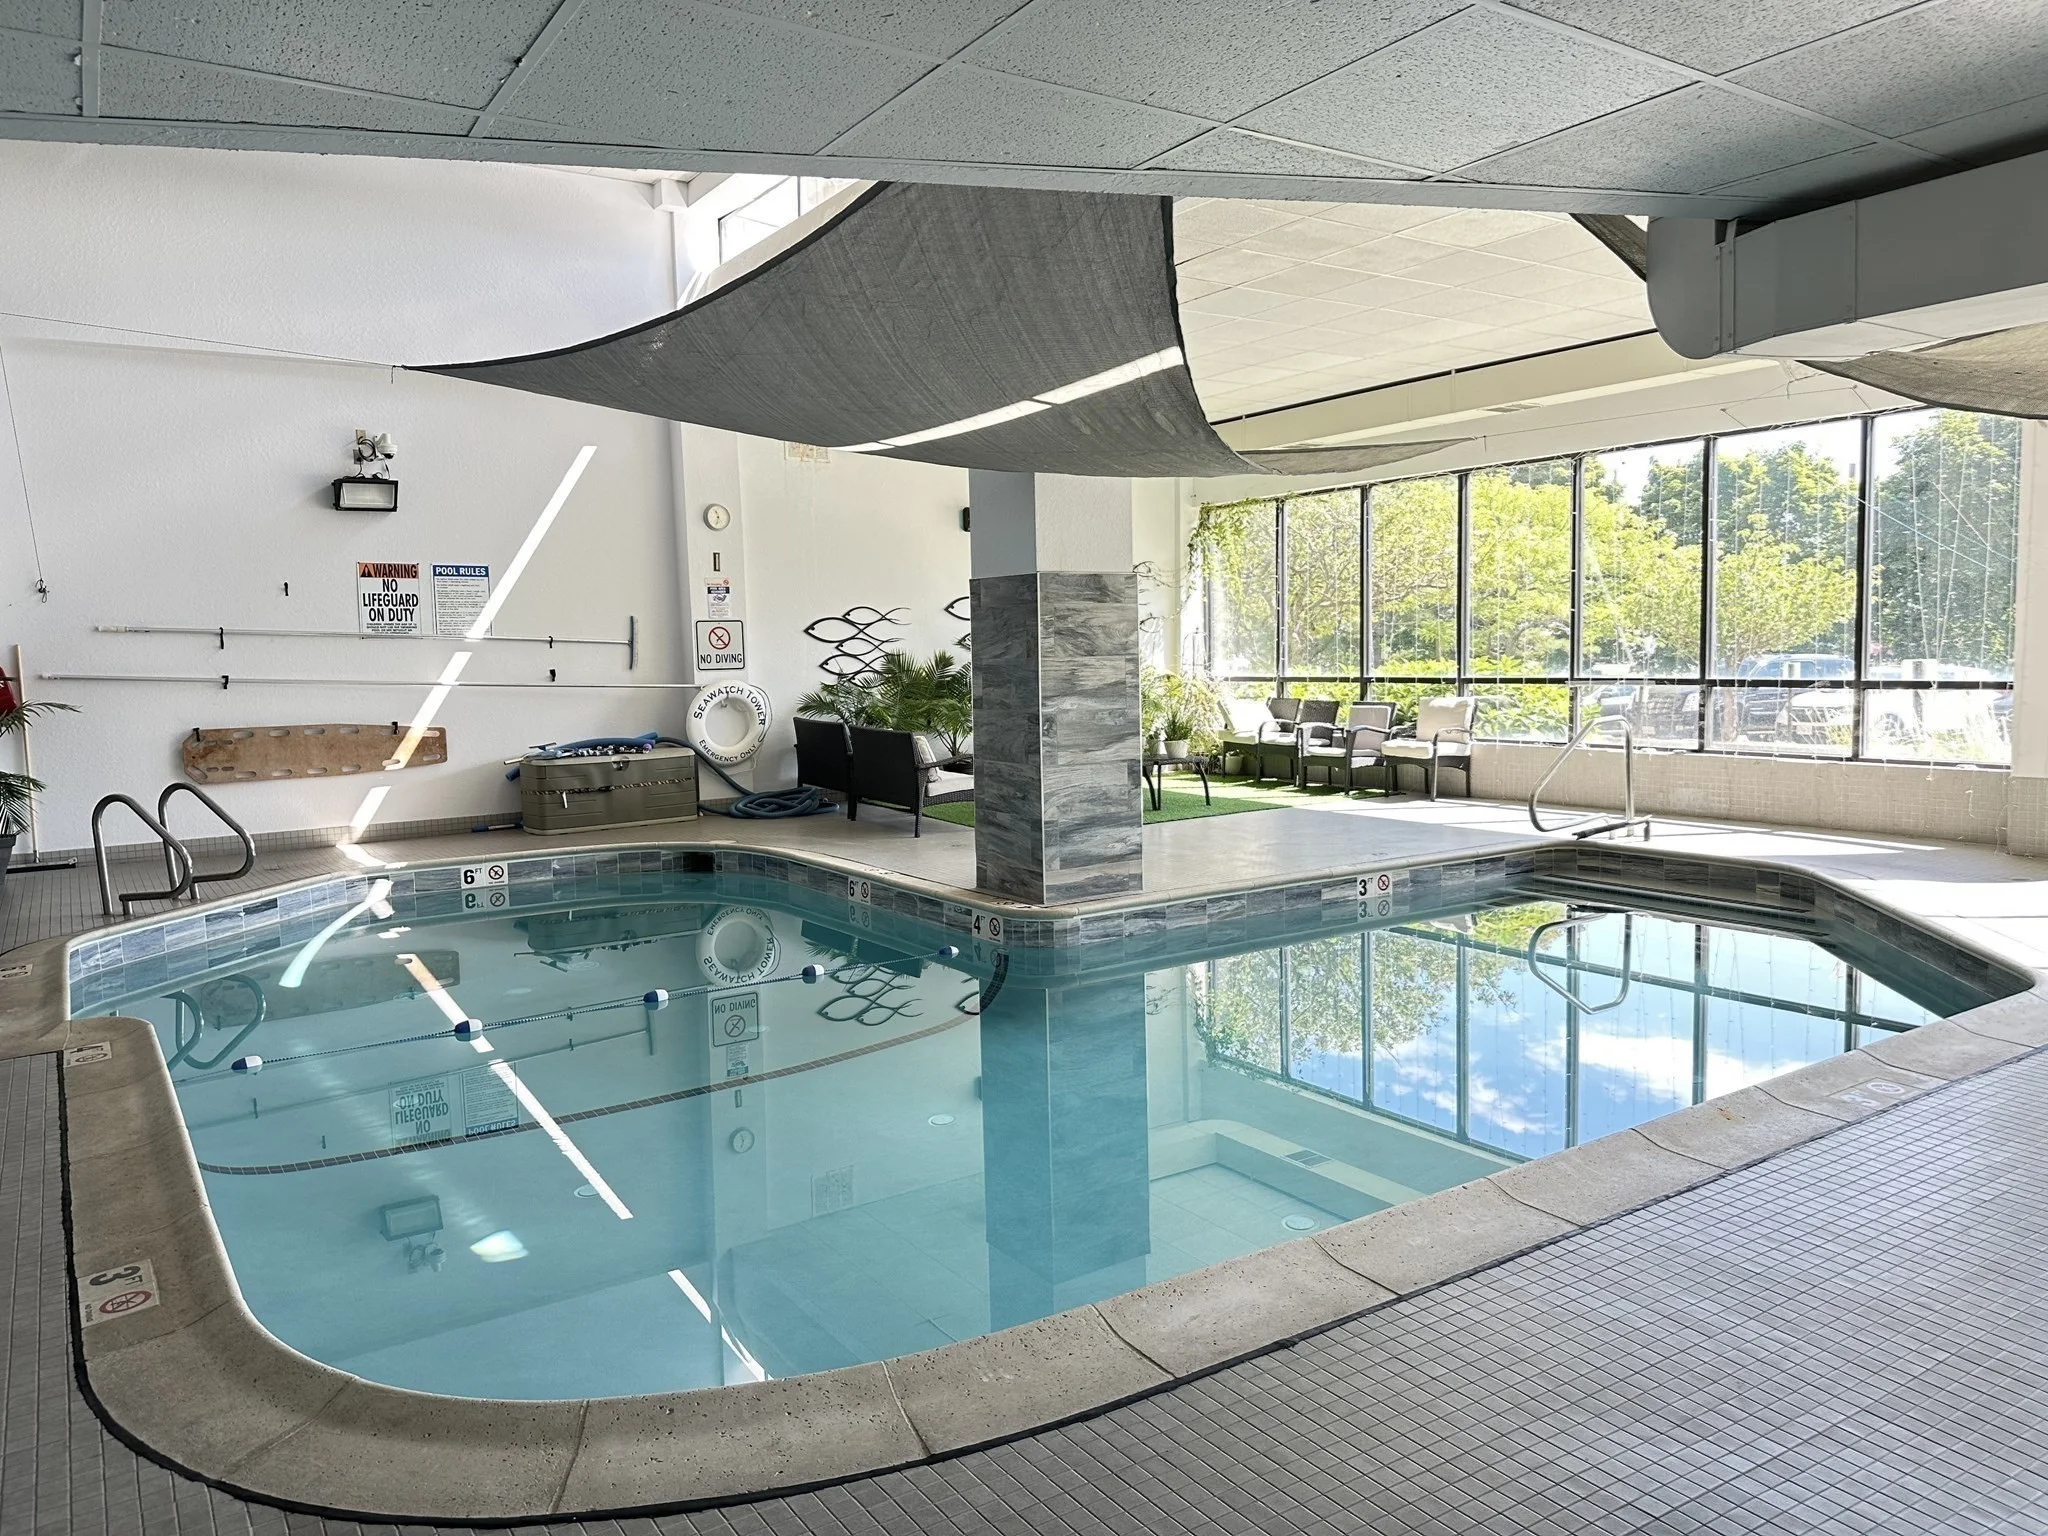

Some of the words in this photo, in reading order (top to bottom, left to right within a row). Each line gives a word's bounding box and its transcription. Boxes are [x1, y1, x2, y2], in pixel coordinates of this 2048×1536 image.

[373, 563, 418, 578] WARNING
[435, 566, 458, 575] POOL
[460, 567, 486, 576] RULES
[382, 579, 398, 592] NO
[363, 593, 419, 607] LIFEGUARD
[369, 608, 384, 621] ON
[388, 608, 414, 622] DUTY
[700, 654, 712, 664] NO
[715, 653, 743, 664] DIVING
[693, 686, 744, 719] SEAWATCH
[746, 689, 766, 726] TOWER
[699, 739, 738, 762] EMERGENCY
[740, 743, 757, 759] ONLY
[463, 869, 475, 885] 6
[1359, 879, 1367, 896] 3
[973, 914, 981, 934] 4
[89, 1265, 141, 1286] 3
